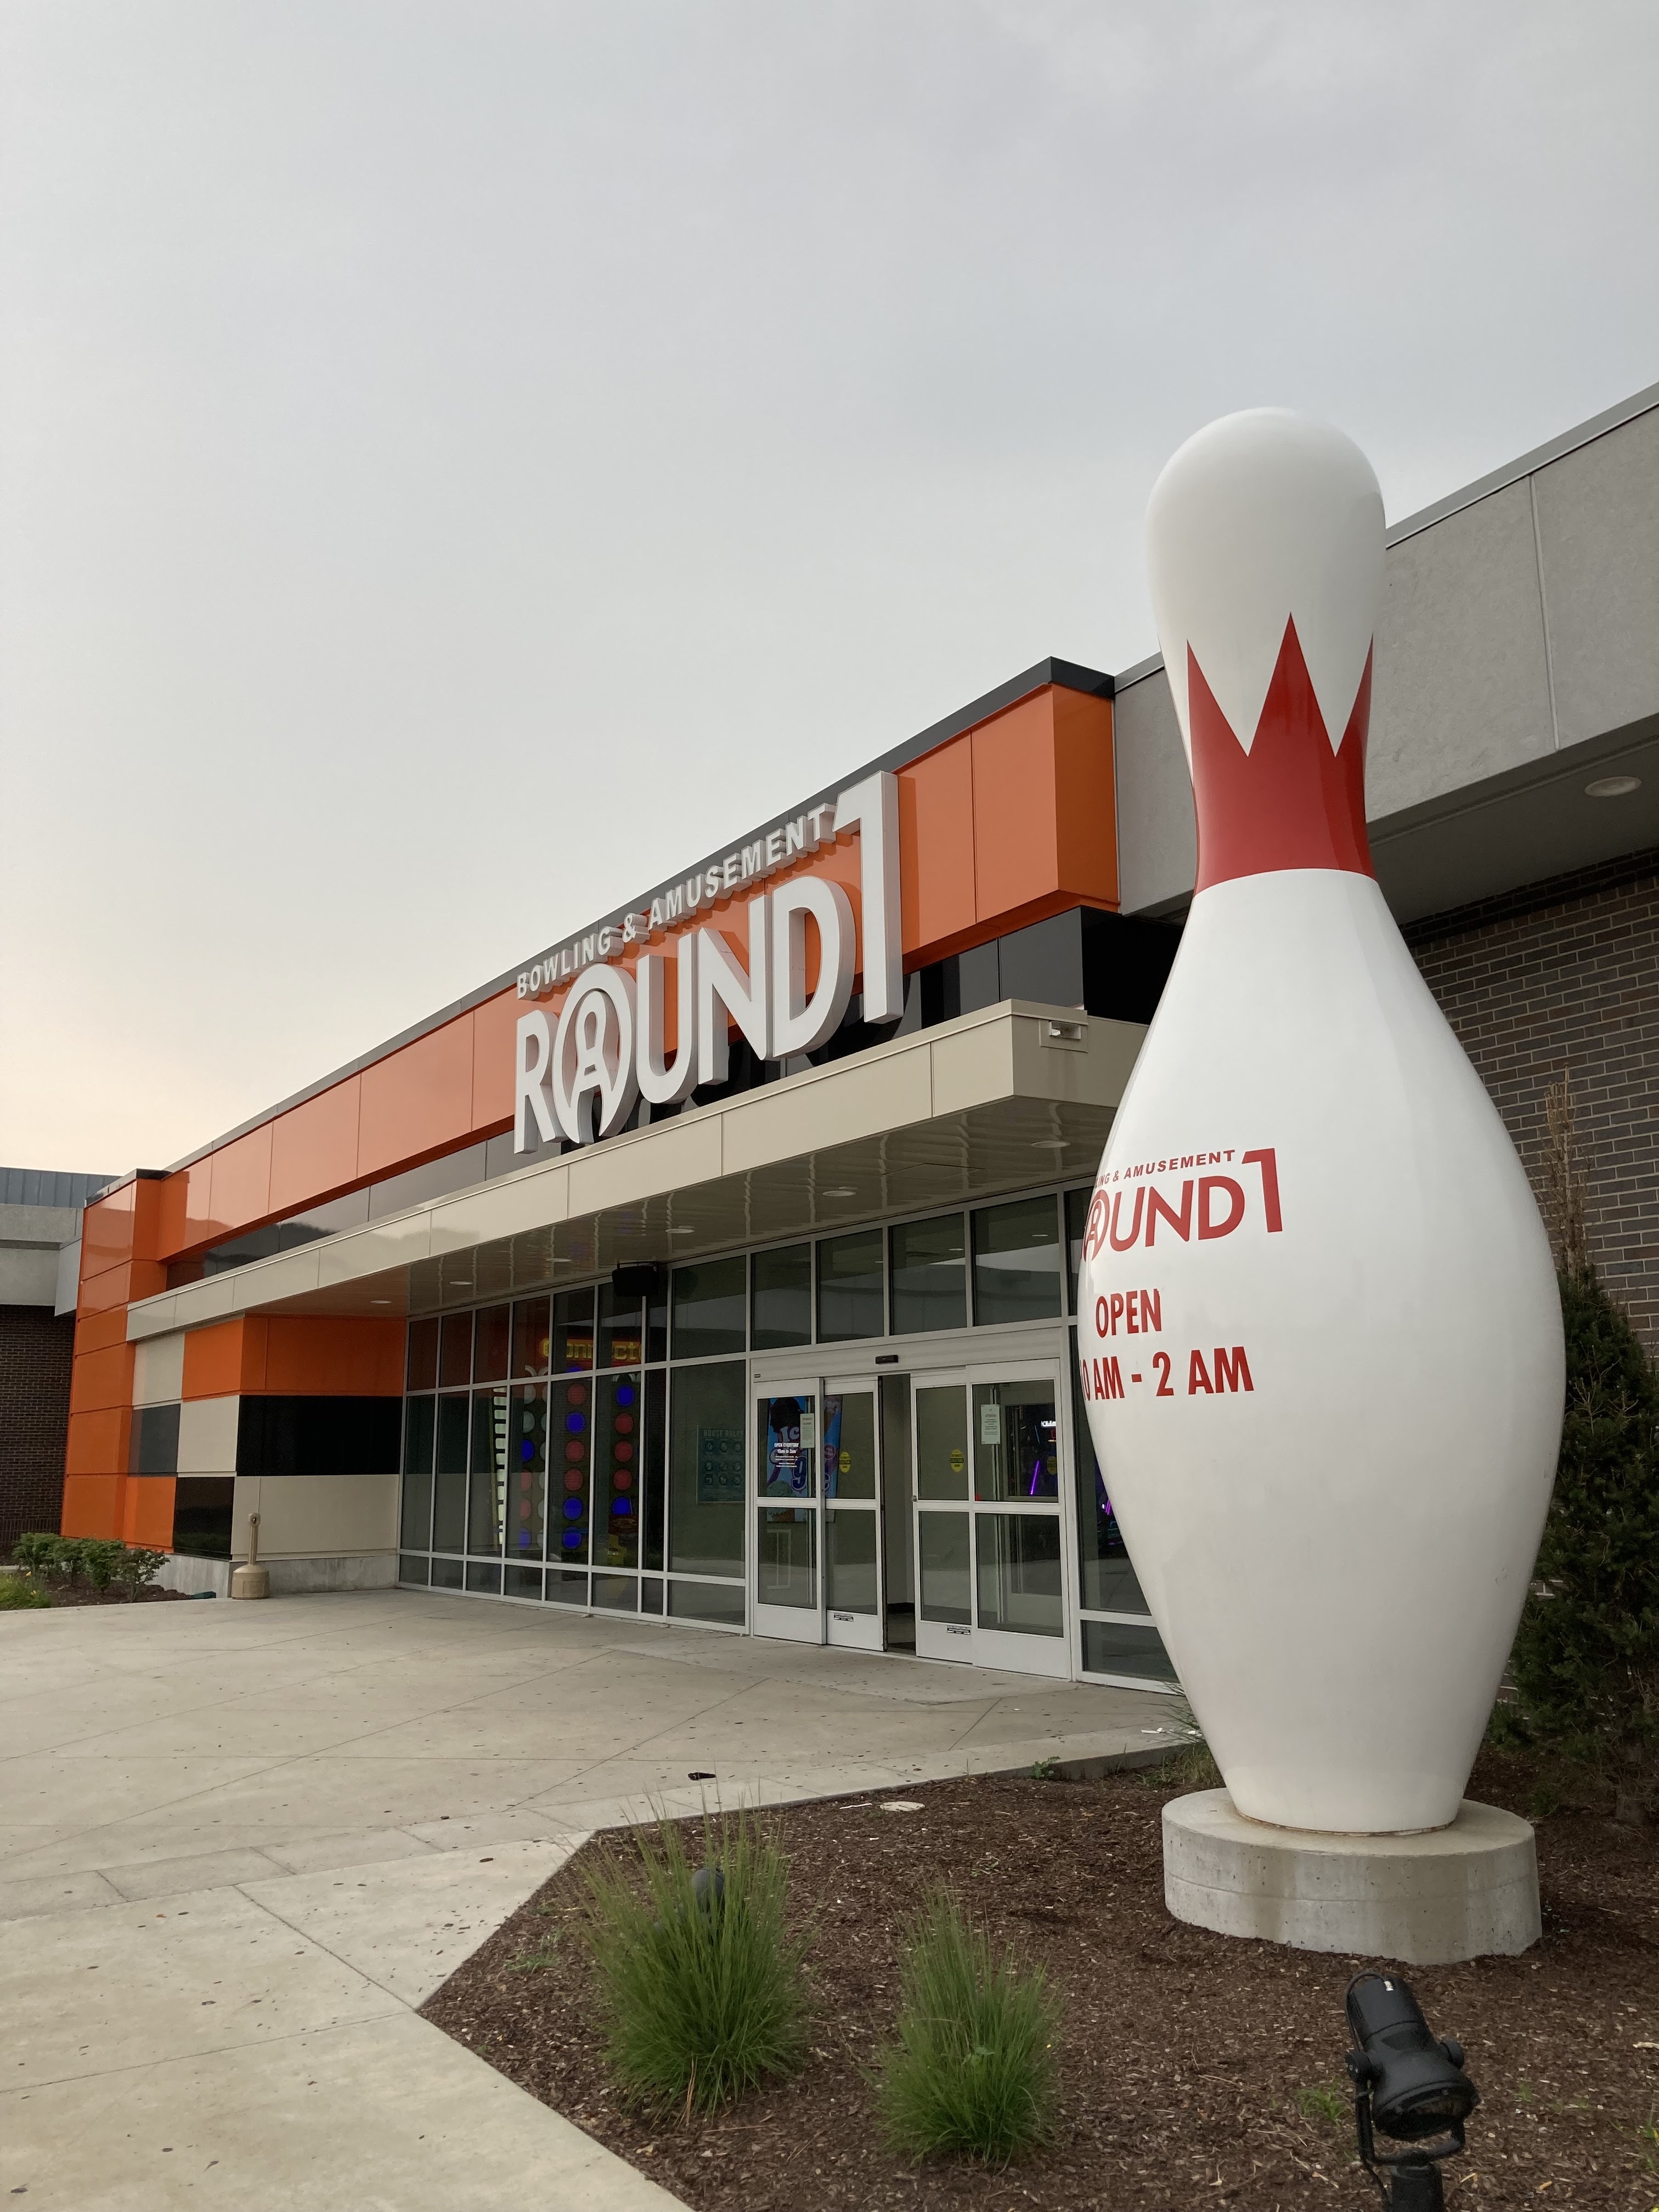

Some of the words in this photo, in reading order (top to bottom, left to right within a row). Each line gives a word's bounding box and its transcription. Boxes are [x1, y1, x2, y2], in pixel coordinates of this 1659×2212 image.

[517, 928, 619, 1000] BOWLING
[622, 912, 650, 943] &
[648, 803, 836, 930] AMUSEMENT
[1113, 1170, 1120, 1182] &
[1124, 1149, 1235, 1180] AMUSEMENT
[1082, 1148, 1283, 1262] OUND1
[1096, 1288, 1162, 1338] OPEN
[1093, 1356, 1125, 1400] AM
[1153, 1351, 1175, 1397] 2
[1188, 1346, 1254, 1395] AM
